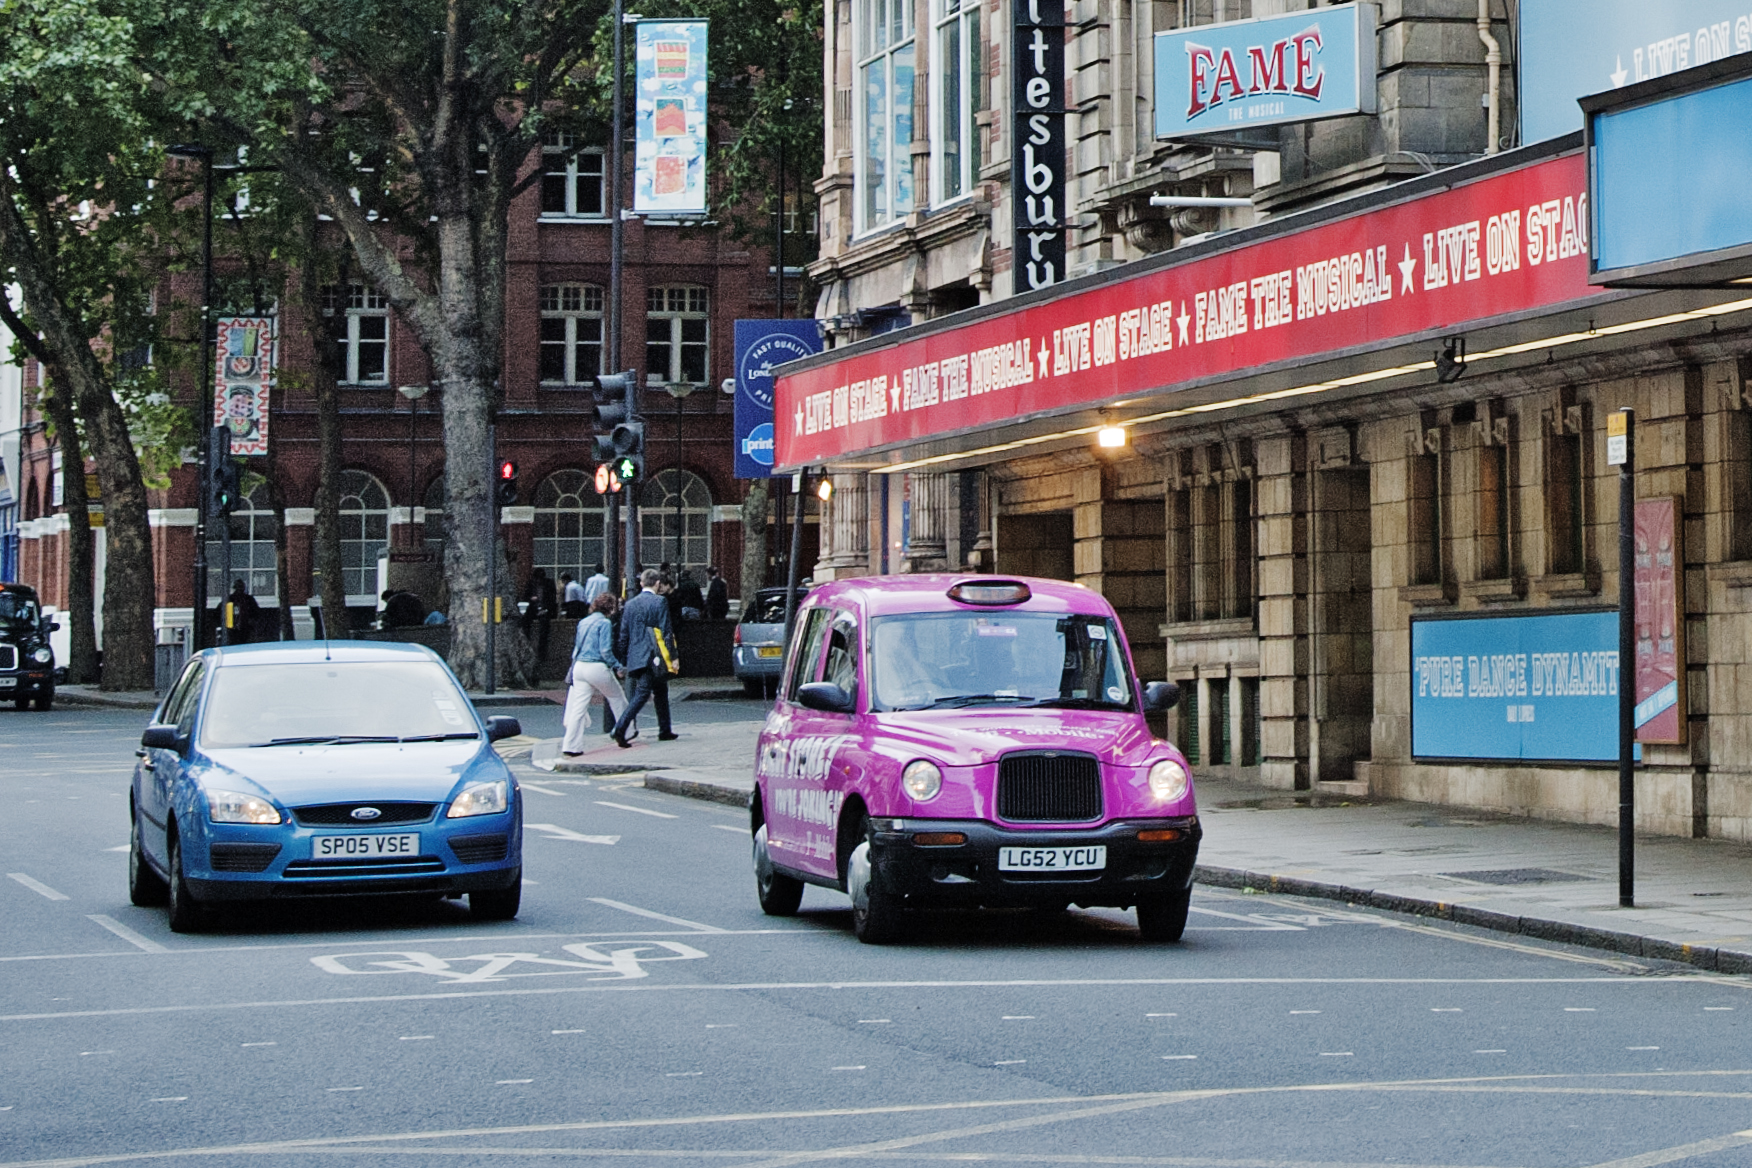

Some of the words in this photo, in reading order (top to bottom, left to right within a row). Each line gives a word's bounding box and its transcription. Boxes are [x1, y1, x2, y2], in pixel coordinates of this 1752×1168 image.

[1185, 22, 1326, 121] FAME
[1633, 32, 1690, 82] LIVE
[1694, 20, 1731, 65] ON
[805, 390, 833, 435] LIVE
[833, 387, 849, 428] ON
[850, 375, 888, 423] STAGE
[903, 362, 939, 410] FAME
[940, 354, 968, 402] THE
[970, 338, 1034, 395] MUSICAL
[1053, 321, 1091, 376] LIVE
[1093, 315, 1116, 366] ON
[1119, 301, 1172, 359] STAGE
[1195, 280, 1248, 343] FAME
[1251, 270, 1293, 330] THE
[1296, 245, 1391, 320] MUSICAL
[1423, 220, 1481, 290] LIVE
[1486, 209, 1520, 275] ON
[753, 342, 771, 359] FAST
[1468, 653, 1527, 697] DANCE
[321, 838, 369, 854] SP05
[376, 836, 411, 853] VSE
[1007, 850, 1056, 867] LG52
[1063, 848, 1098, 866] YCU
